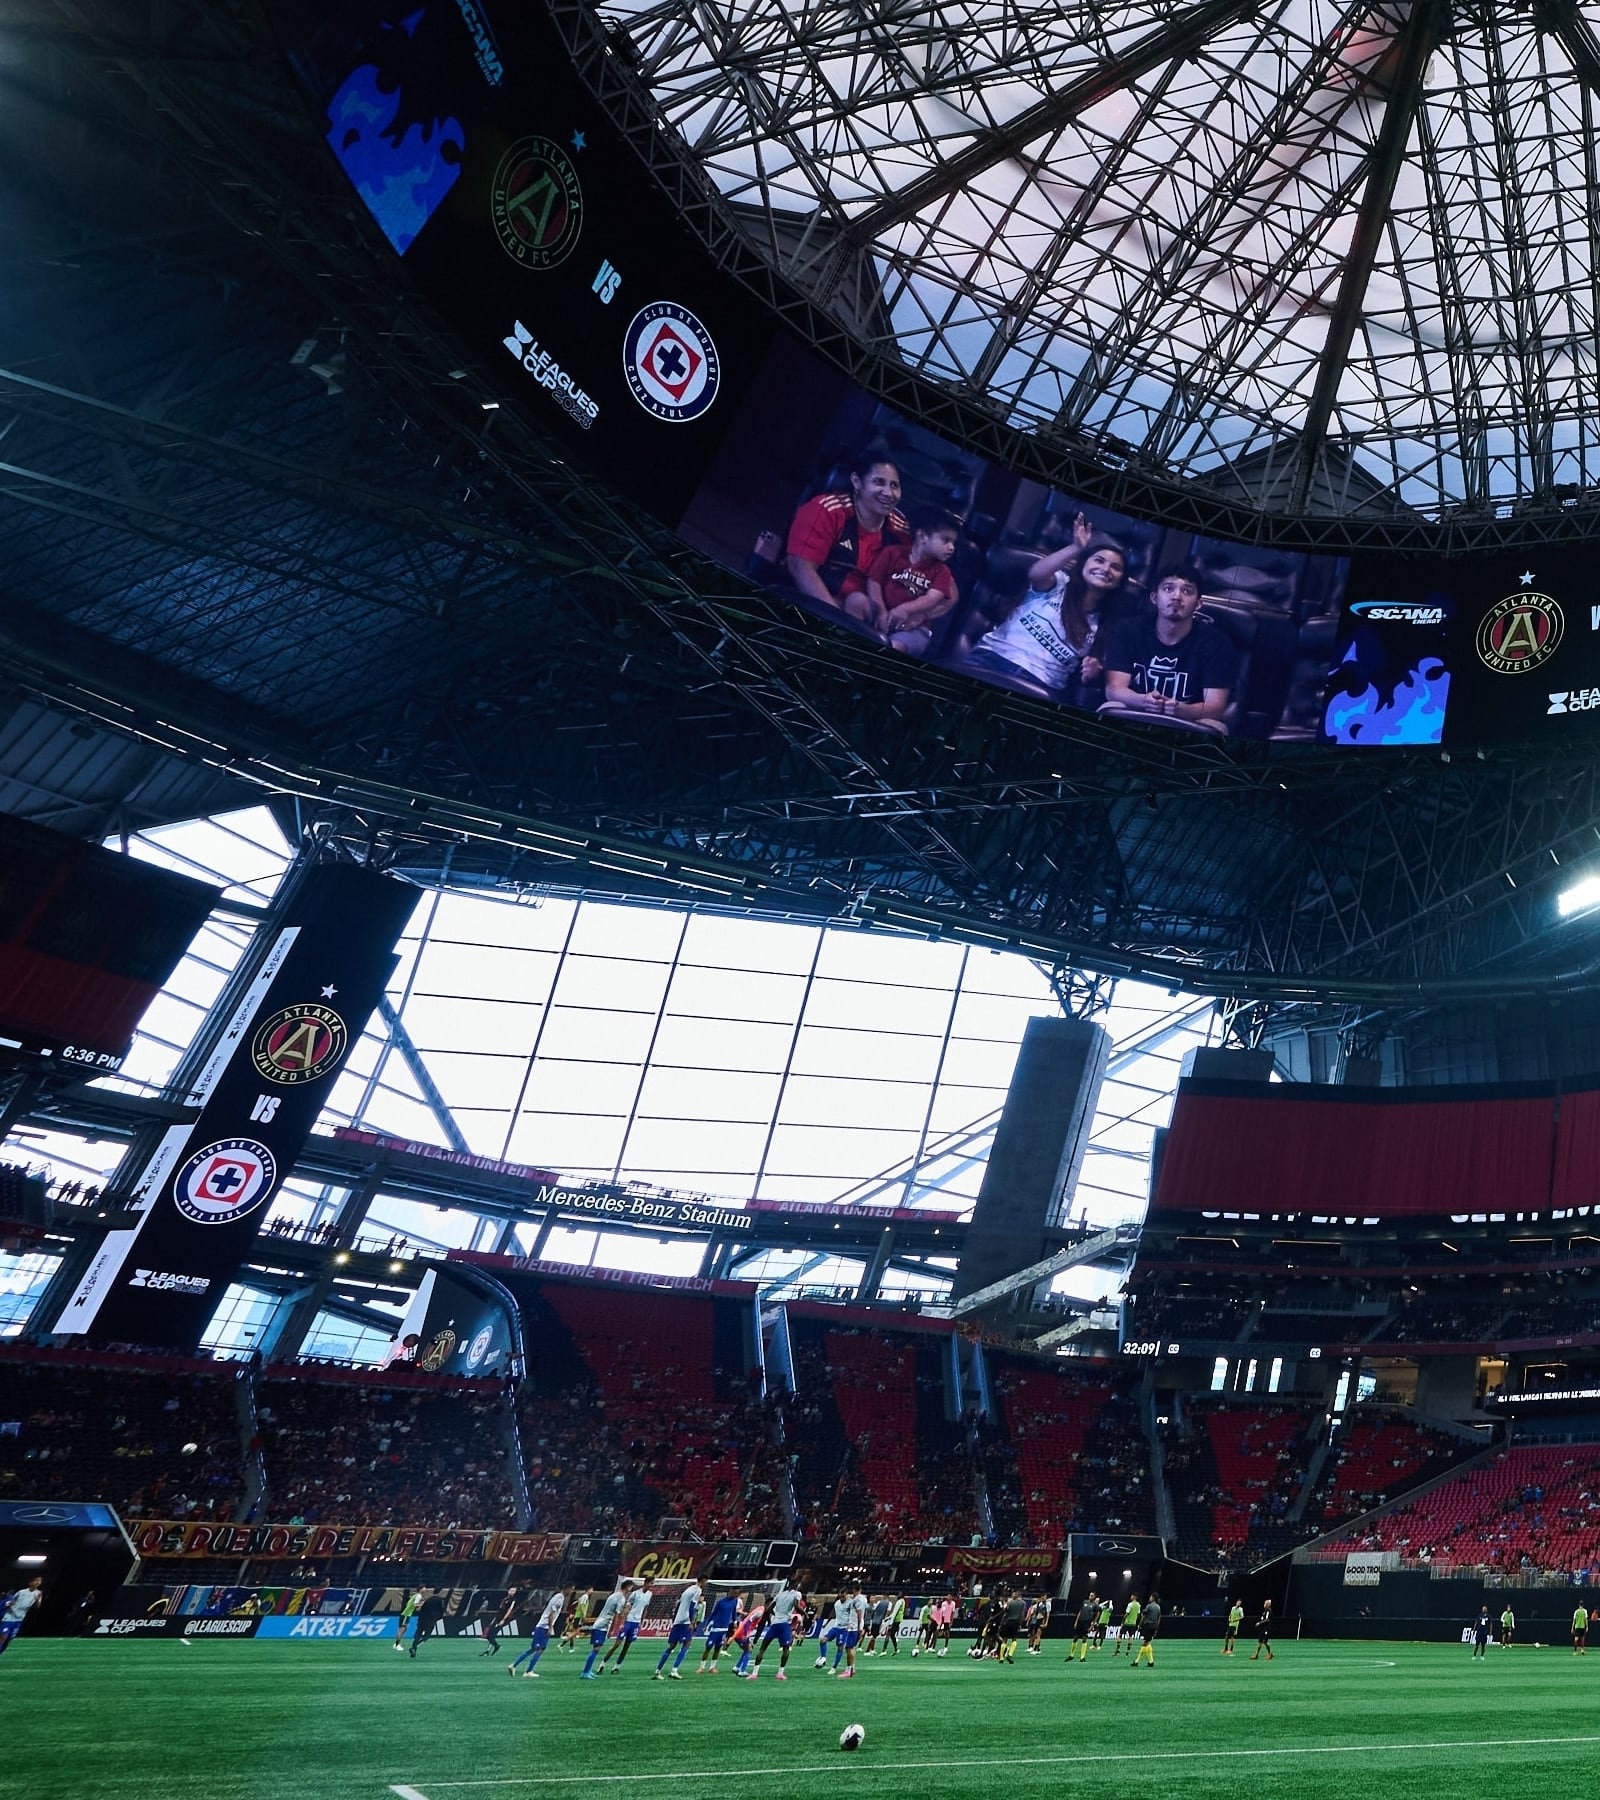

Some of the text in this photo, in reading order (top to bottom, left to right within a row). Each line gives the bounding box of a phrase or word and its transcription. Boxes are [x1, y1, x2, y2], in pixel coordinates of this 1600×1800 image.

[456, 0, 503, 82] CANA
[532, 140, 581, 210] ATLANTA
[495, 190, 550, 264] UNITED FC
[592, 258, 622, 304] VS
[523, 355, 558, 391] CUP
[529, 341, 600, 419] LEAGUES
[627, 365, 684, 418] CRUZ AZUL
[1367, 606, 1443, 620] SCANA
[1494, 595, 1554, 616] ATLANTA
[1484, 645, 1552, 671] UNITED FC
[1133, 661, 1193, 700] ATL
[284, 1007, 341, 1034] ATLANTA
[62, 1045, 122, 1069] 6:36 PM
[256, 1052, 323, 1082] UNITED FC
[250, 1094, 281, 1123] VS
[535, 1185, 752, 1229] Mercedes-Benz Stadium
[150, 1271, 211, 1288] LEAGUES
[511, 1255, 597, 1279] WELCOME
[602, 1268, 623, 1281] TO
[628, 1272, 662, 1286] THE
[147, 1279, 176, 1290] CUP
[1123, 1343, 1156, 1355] 32:09
[128, 1523, 186, 1553] LOS
[317, 1525, 356, 1553] DE
[357, 1530, 392, 1553] LA
[394, 1531, 487, 1559] FIESTA
[1016, 1553, 1054, 1568] MOB
[1346, 1565, 1366, 1574] GOOD
[110, 1626, 136, 1634] CUP
[113, 1619, 167, 1628] LEAGUES
[184, 1619, 252, 1636] @LEAGUESCUP
[289, 1617, 390, 1637] AT&T 5G
